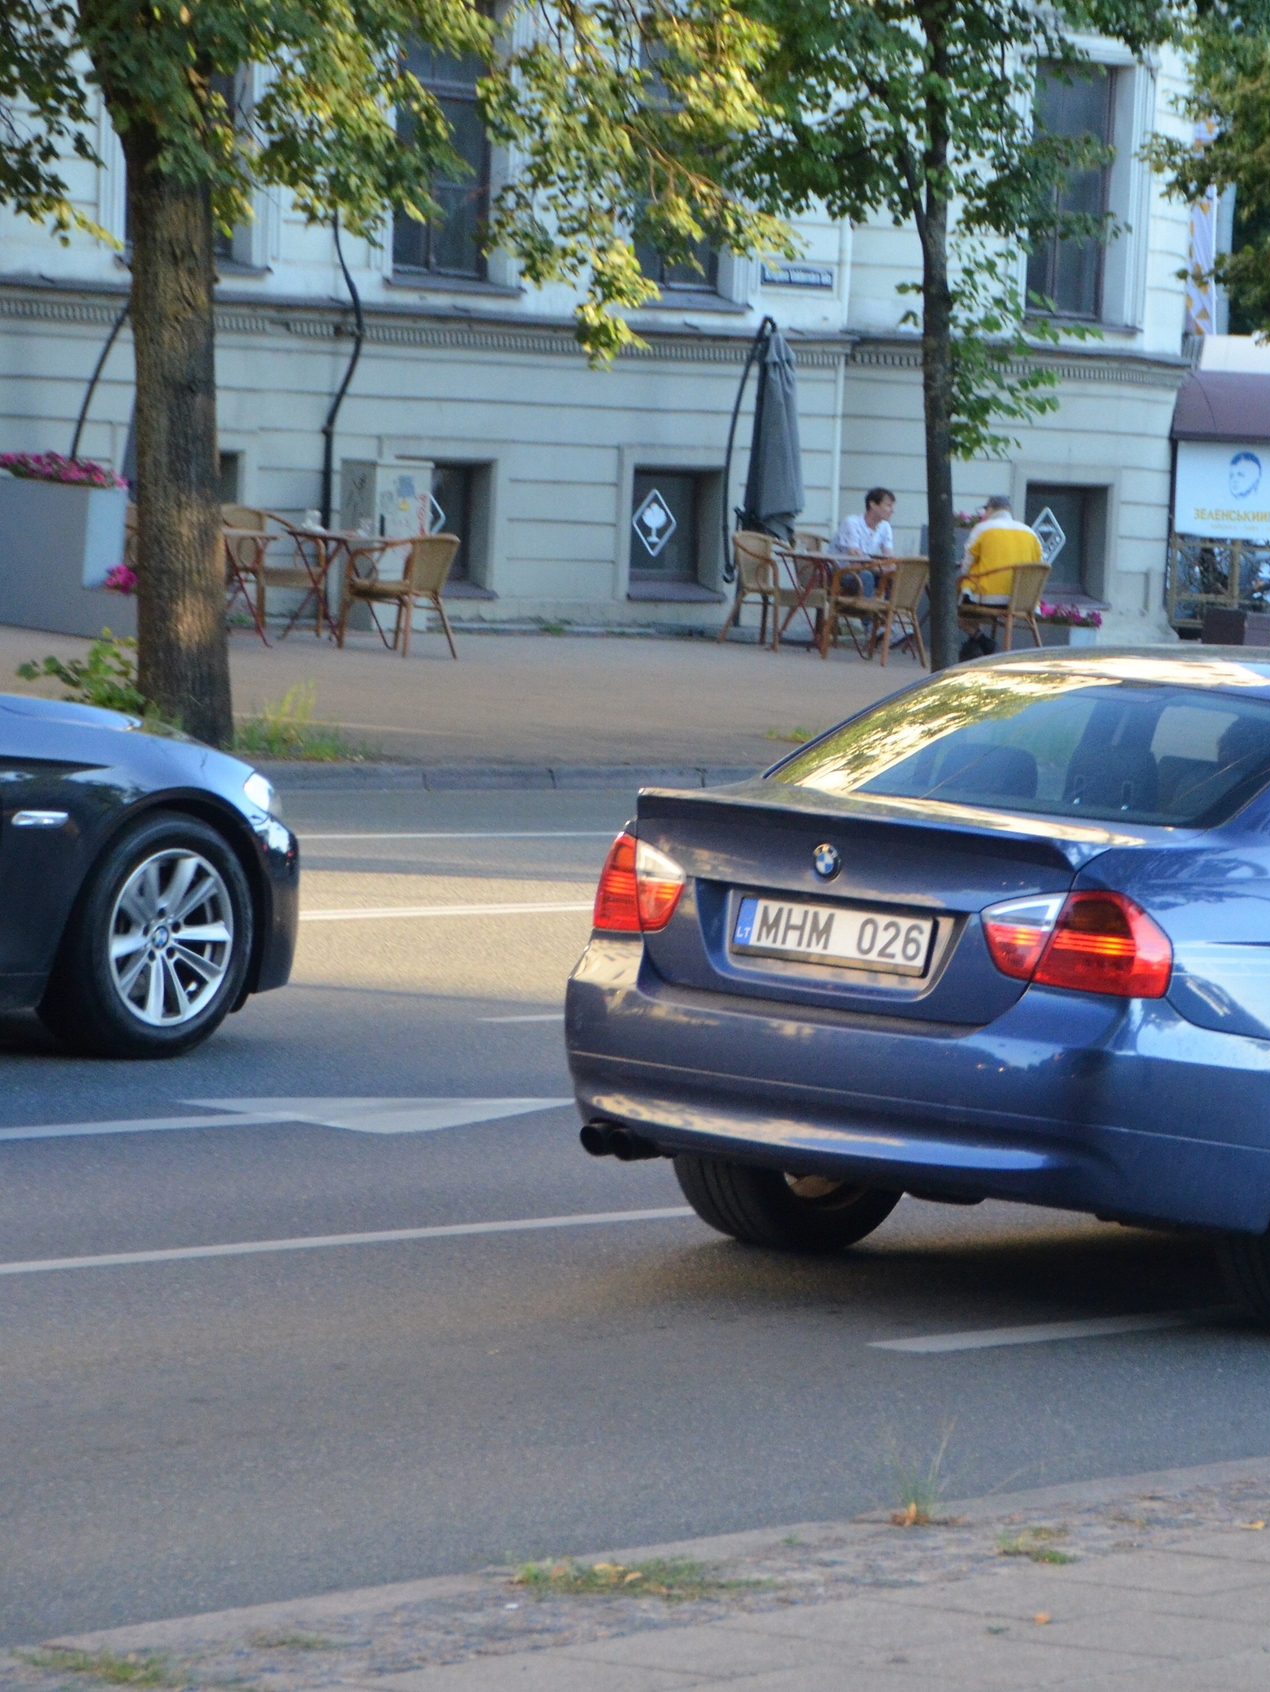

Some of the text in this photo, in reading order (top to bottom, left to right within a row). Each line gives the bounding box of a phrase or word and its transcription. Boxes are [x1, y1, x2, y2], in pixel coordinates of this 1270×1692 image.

[735, 926, 751, 938] LT
[756, 905, 924, 961] MHM 026
